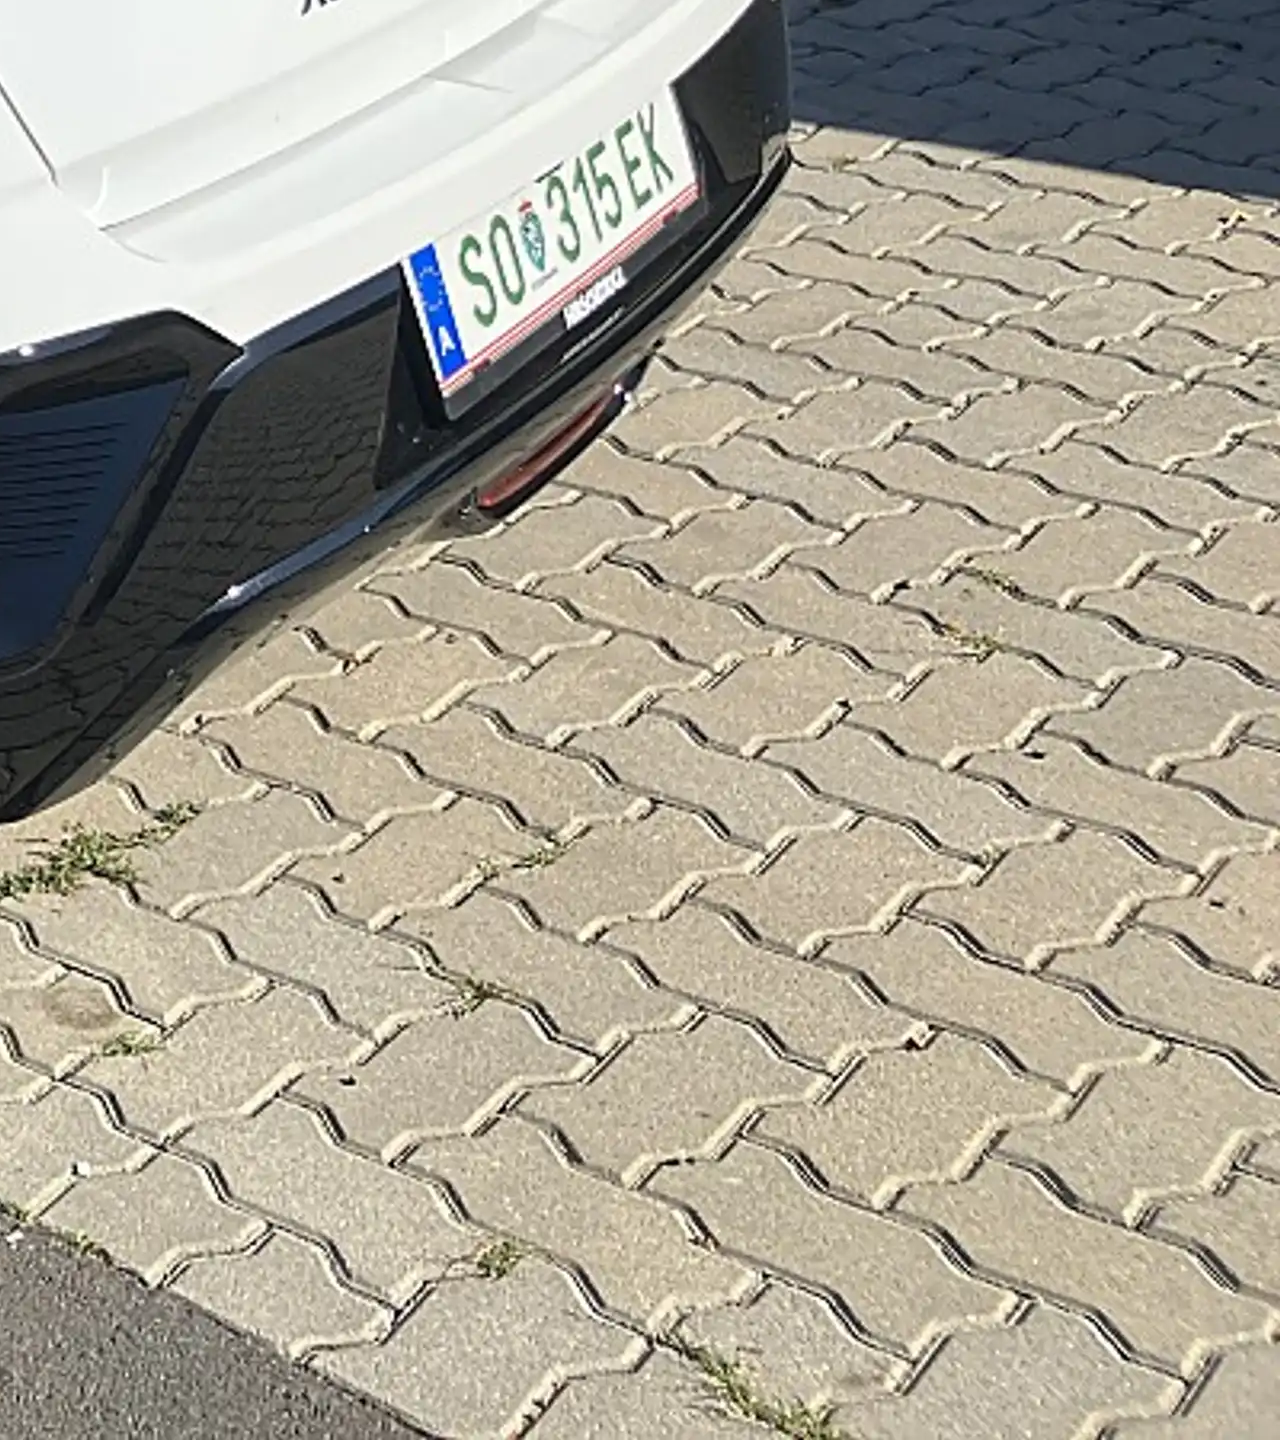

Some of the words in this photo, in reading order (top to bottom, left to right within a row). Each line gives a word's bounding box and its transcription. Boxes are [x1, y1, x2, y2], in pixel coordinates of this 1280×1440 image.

[458, 213, 527, 328] SO
[544, 139, 623, 263] 315
[613, 102, 675, 210] EK
[438, 326, 456, 357] A
